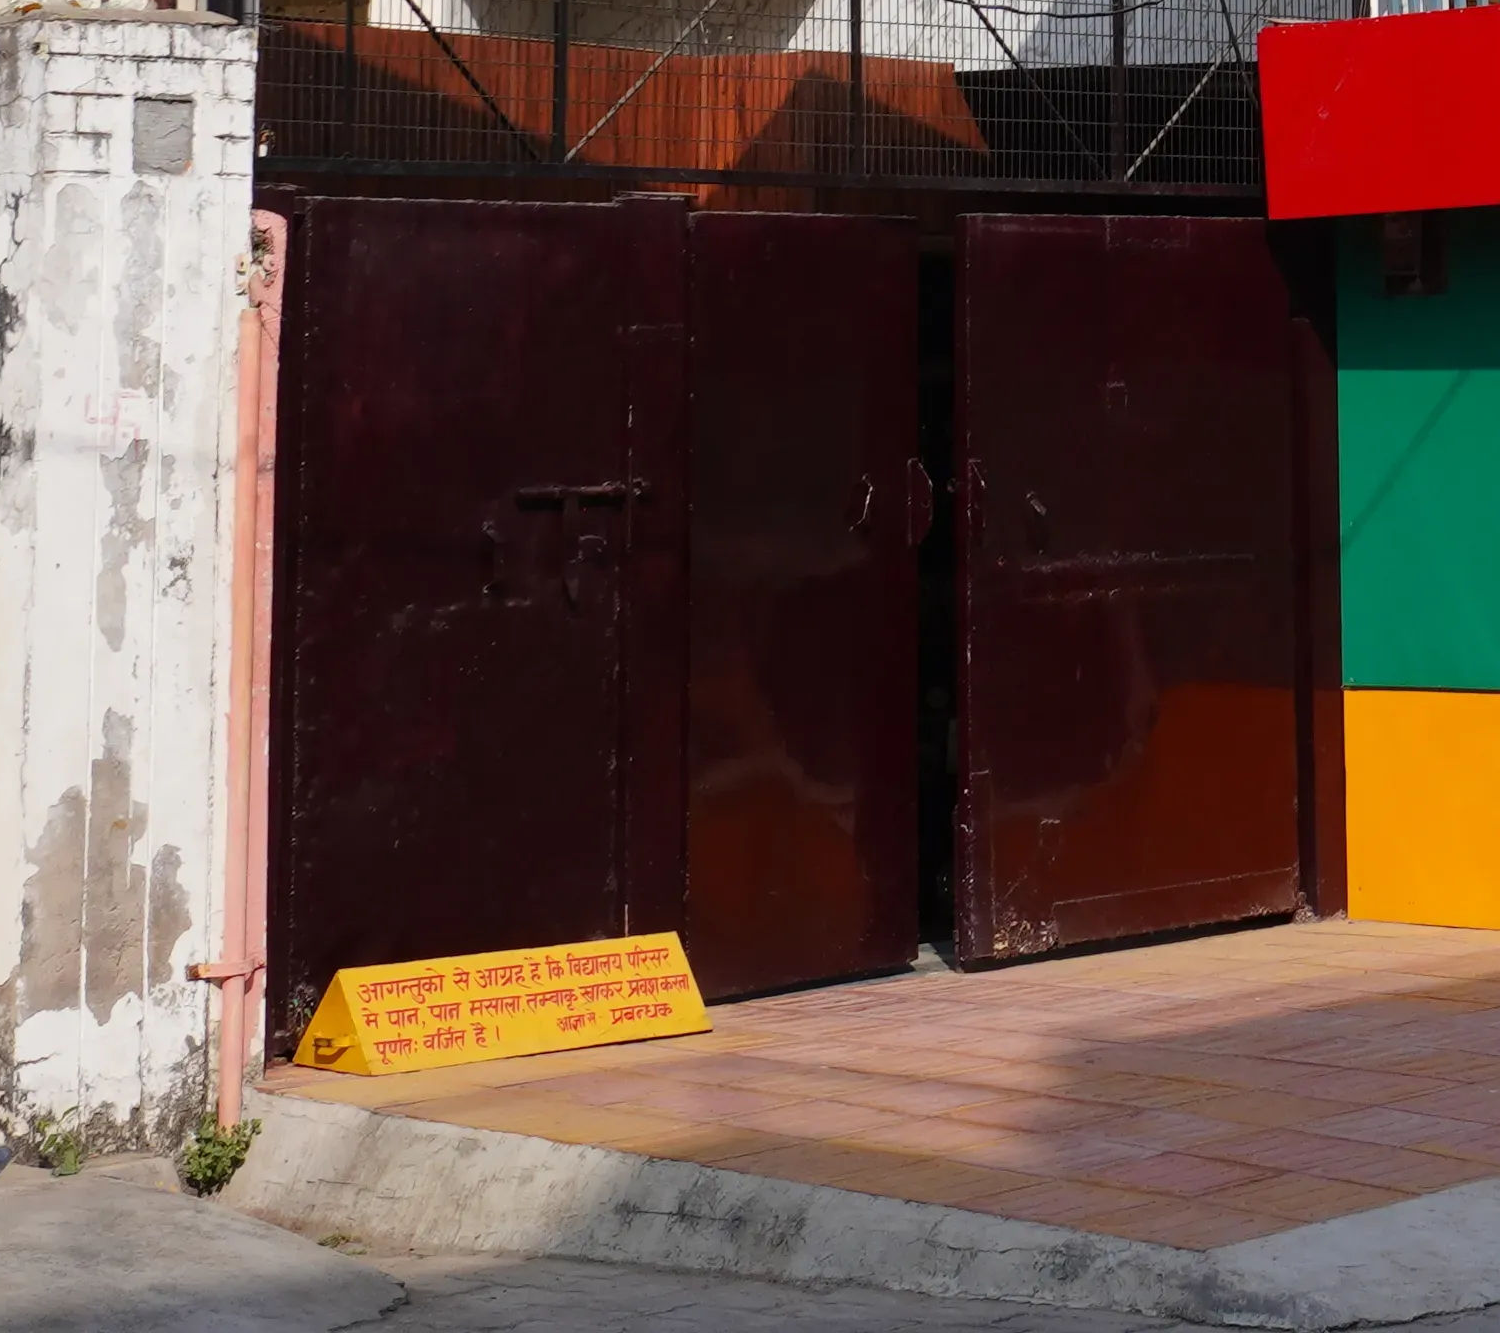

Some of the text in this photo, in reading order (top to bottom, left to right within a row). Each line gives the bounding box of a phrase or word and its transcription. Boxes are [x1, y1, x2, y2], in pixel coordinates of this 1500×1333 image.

[453, 967, 470, 991] से
[475, 964, 532, 989] आग्रह
[545, 955, 565, 981] कि
[566, 952, 623, 977] विद्यालय
[625, 944, 670, 971] परिसर
[427, 1002, 462, 1023] पान
